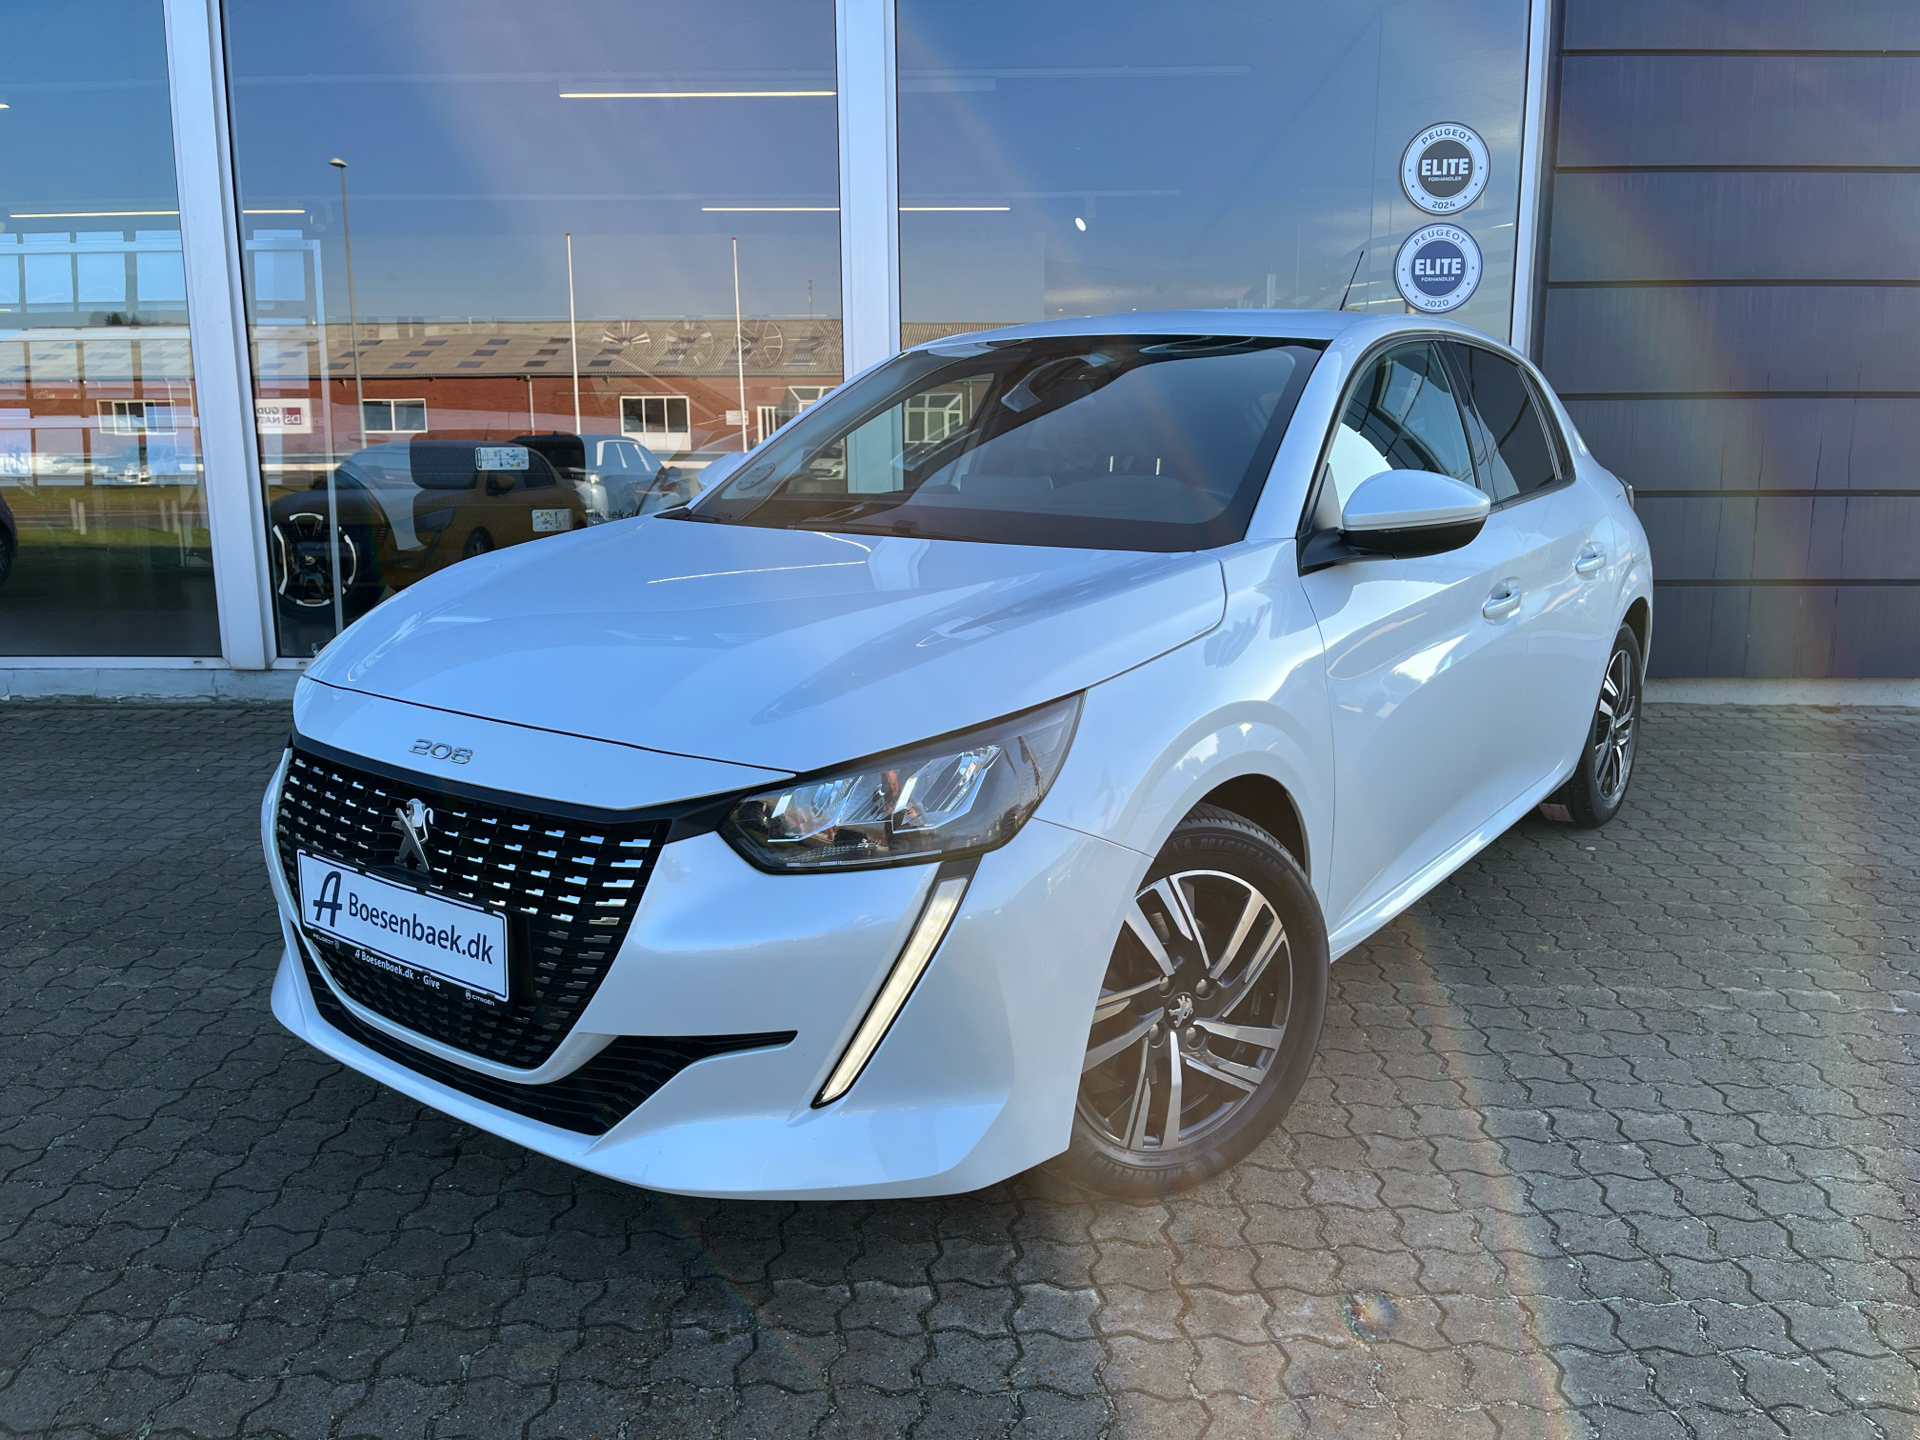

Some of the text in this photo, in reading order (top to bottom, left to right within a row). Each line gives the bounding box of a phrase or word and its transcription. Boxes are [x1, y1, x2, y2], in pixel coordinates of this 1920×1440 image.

[1421, 128, 1473, 145] PEUGEOT
[1421, 158, 1469, 176] ELITE
[1432, 201, 1455, 210] 2024
[1414, 229, 1466, 246] PEUGEOT
[1414, 258, 1462, 275] ELITE
[1424, 299, 1449, 308] 2020
[408, 738, 474, 764] 208
[1198, 838, 1284, 880] MICHELIN
[349, 892, 494, 965] Boesenbaek.dk
[361, 951, 414, 980] Boesenbaek.dk
[423, 975, 441, 990] Give
[1091, 1156, 1182, 1187] MICHELIN
